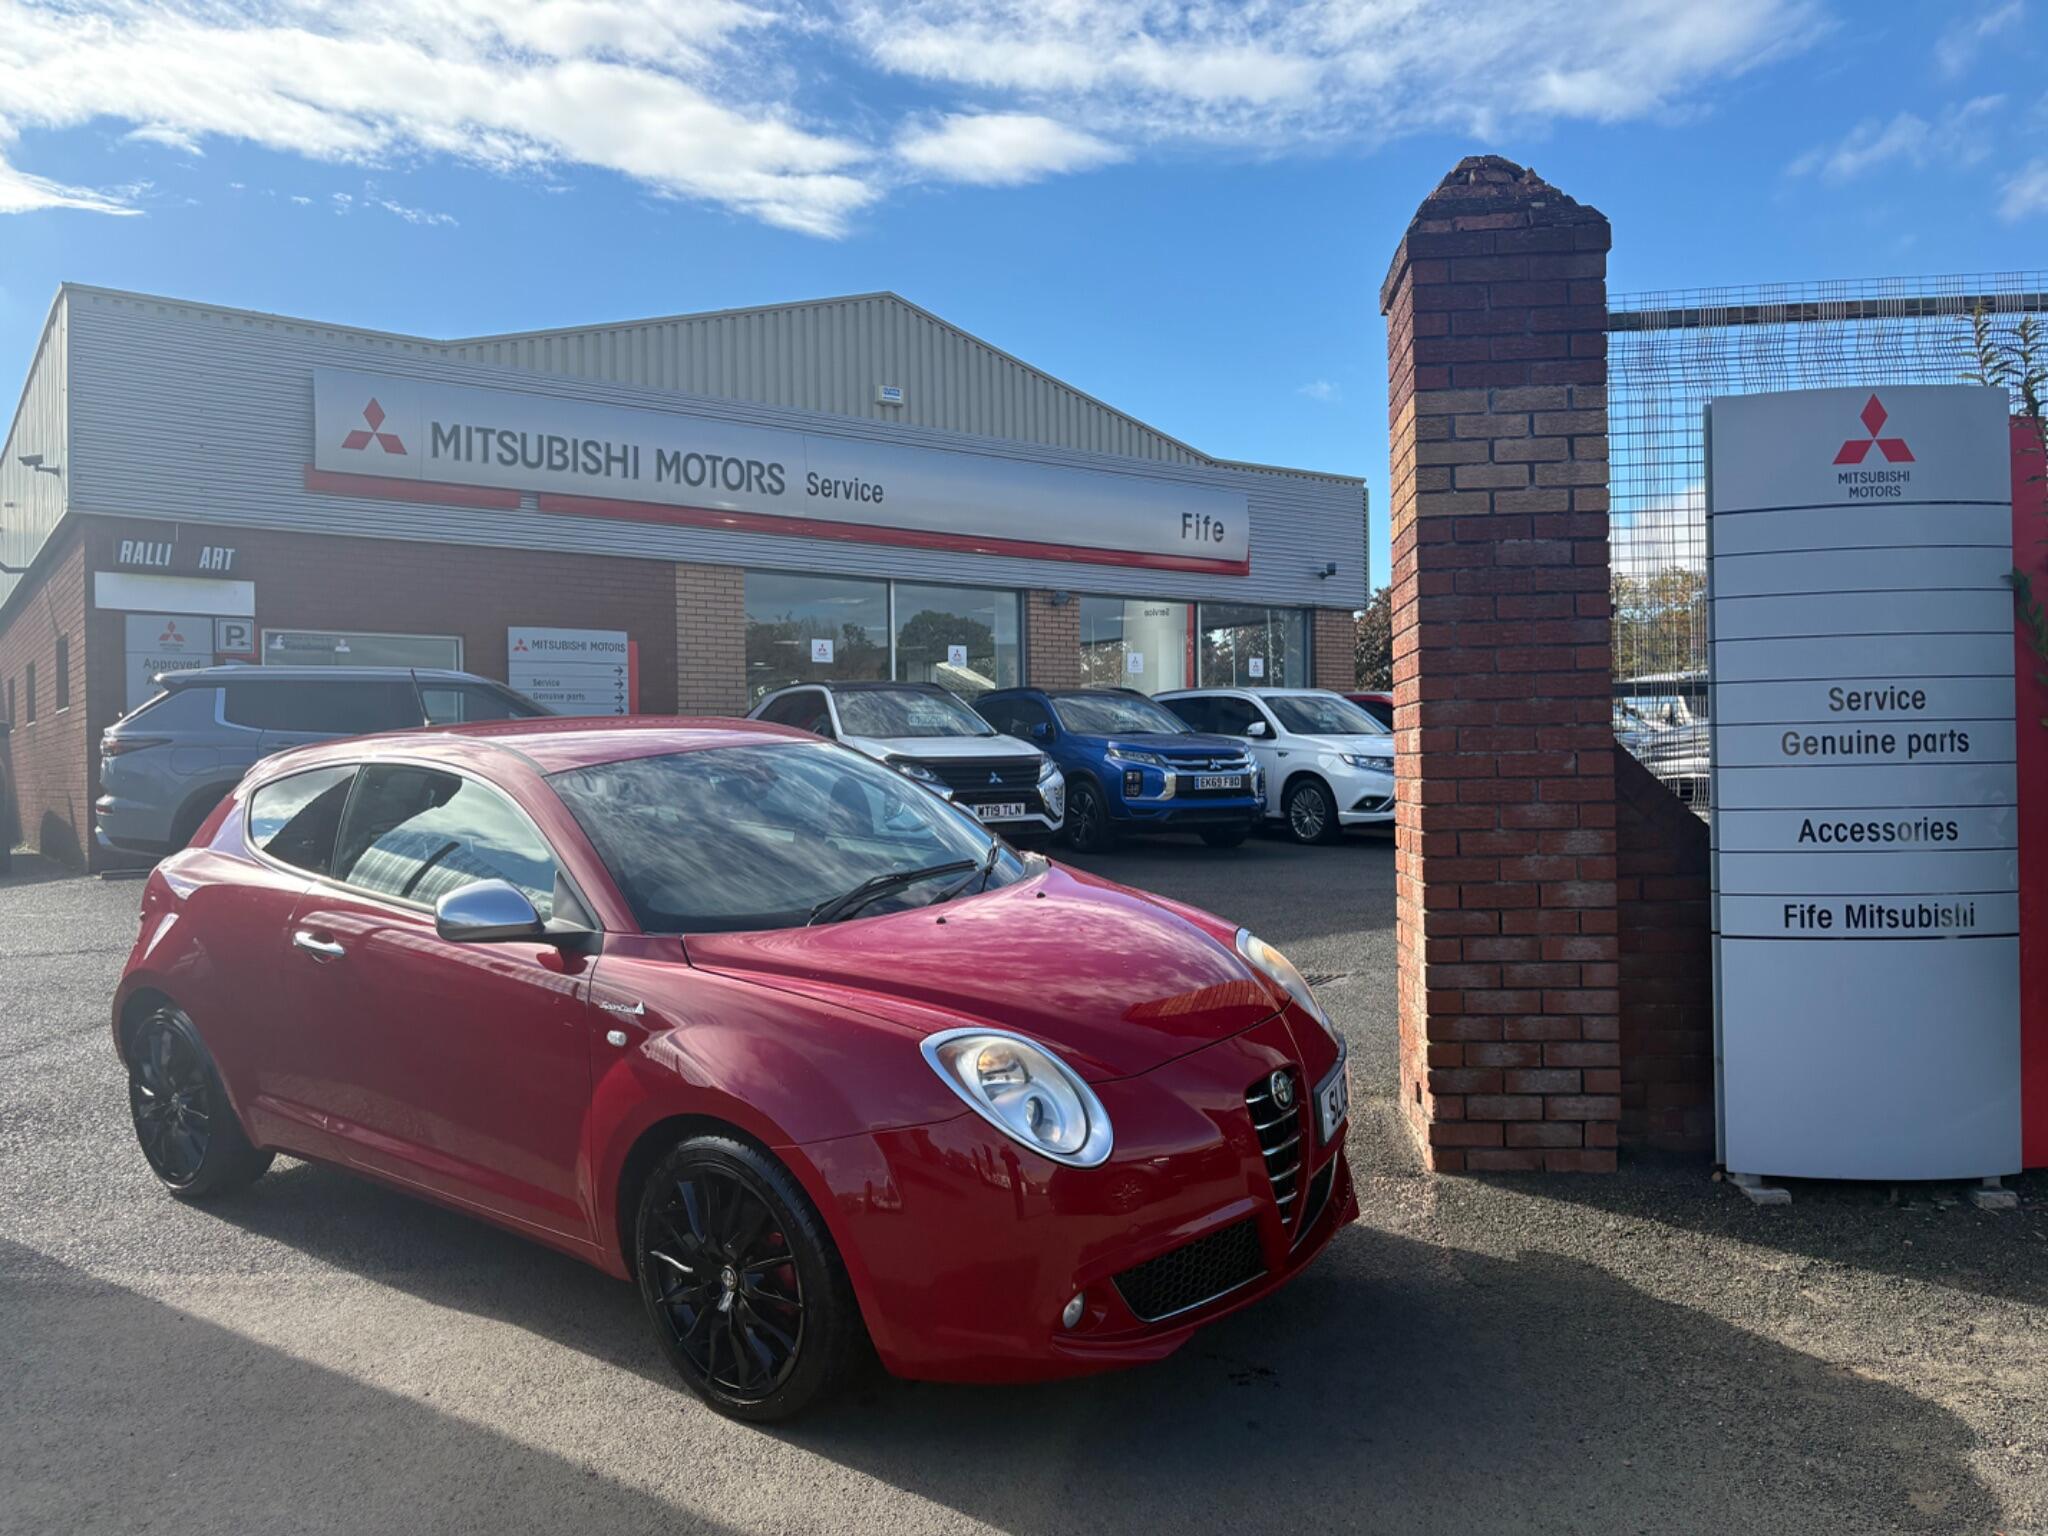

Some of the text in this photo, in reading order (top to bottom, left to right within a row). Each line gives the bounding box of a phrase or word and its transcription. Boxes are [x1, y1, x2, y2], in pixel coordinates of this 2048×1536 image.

[431, 421, 883, 503] MITSUBISHI MOTORS Service
[1838, 469, 1910, 484] MITSUBISHI
[1849, 485, 1902, 498] MOTORS
[1182, 512, 1225, 543] Fife
[119, 540, 235, 570] RALLI ART
[531, 639, 626, 653] MITSUBISHI MOTORS
[143, 656, 200, 673] Approved
[533, 679, 560, 687] Service
[1829, 686, 1926, 712] Service
[1782, 729, 1970, 759] Genuine parts
[1798, 816, 1959, 843] Accessories
[1784, 902, 1975, 929] Fife Mitsubishi
